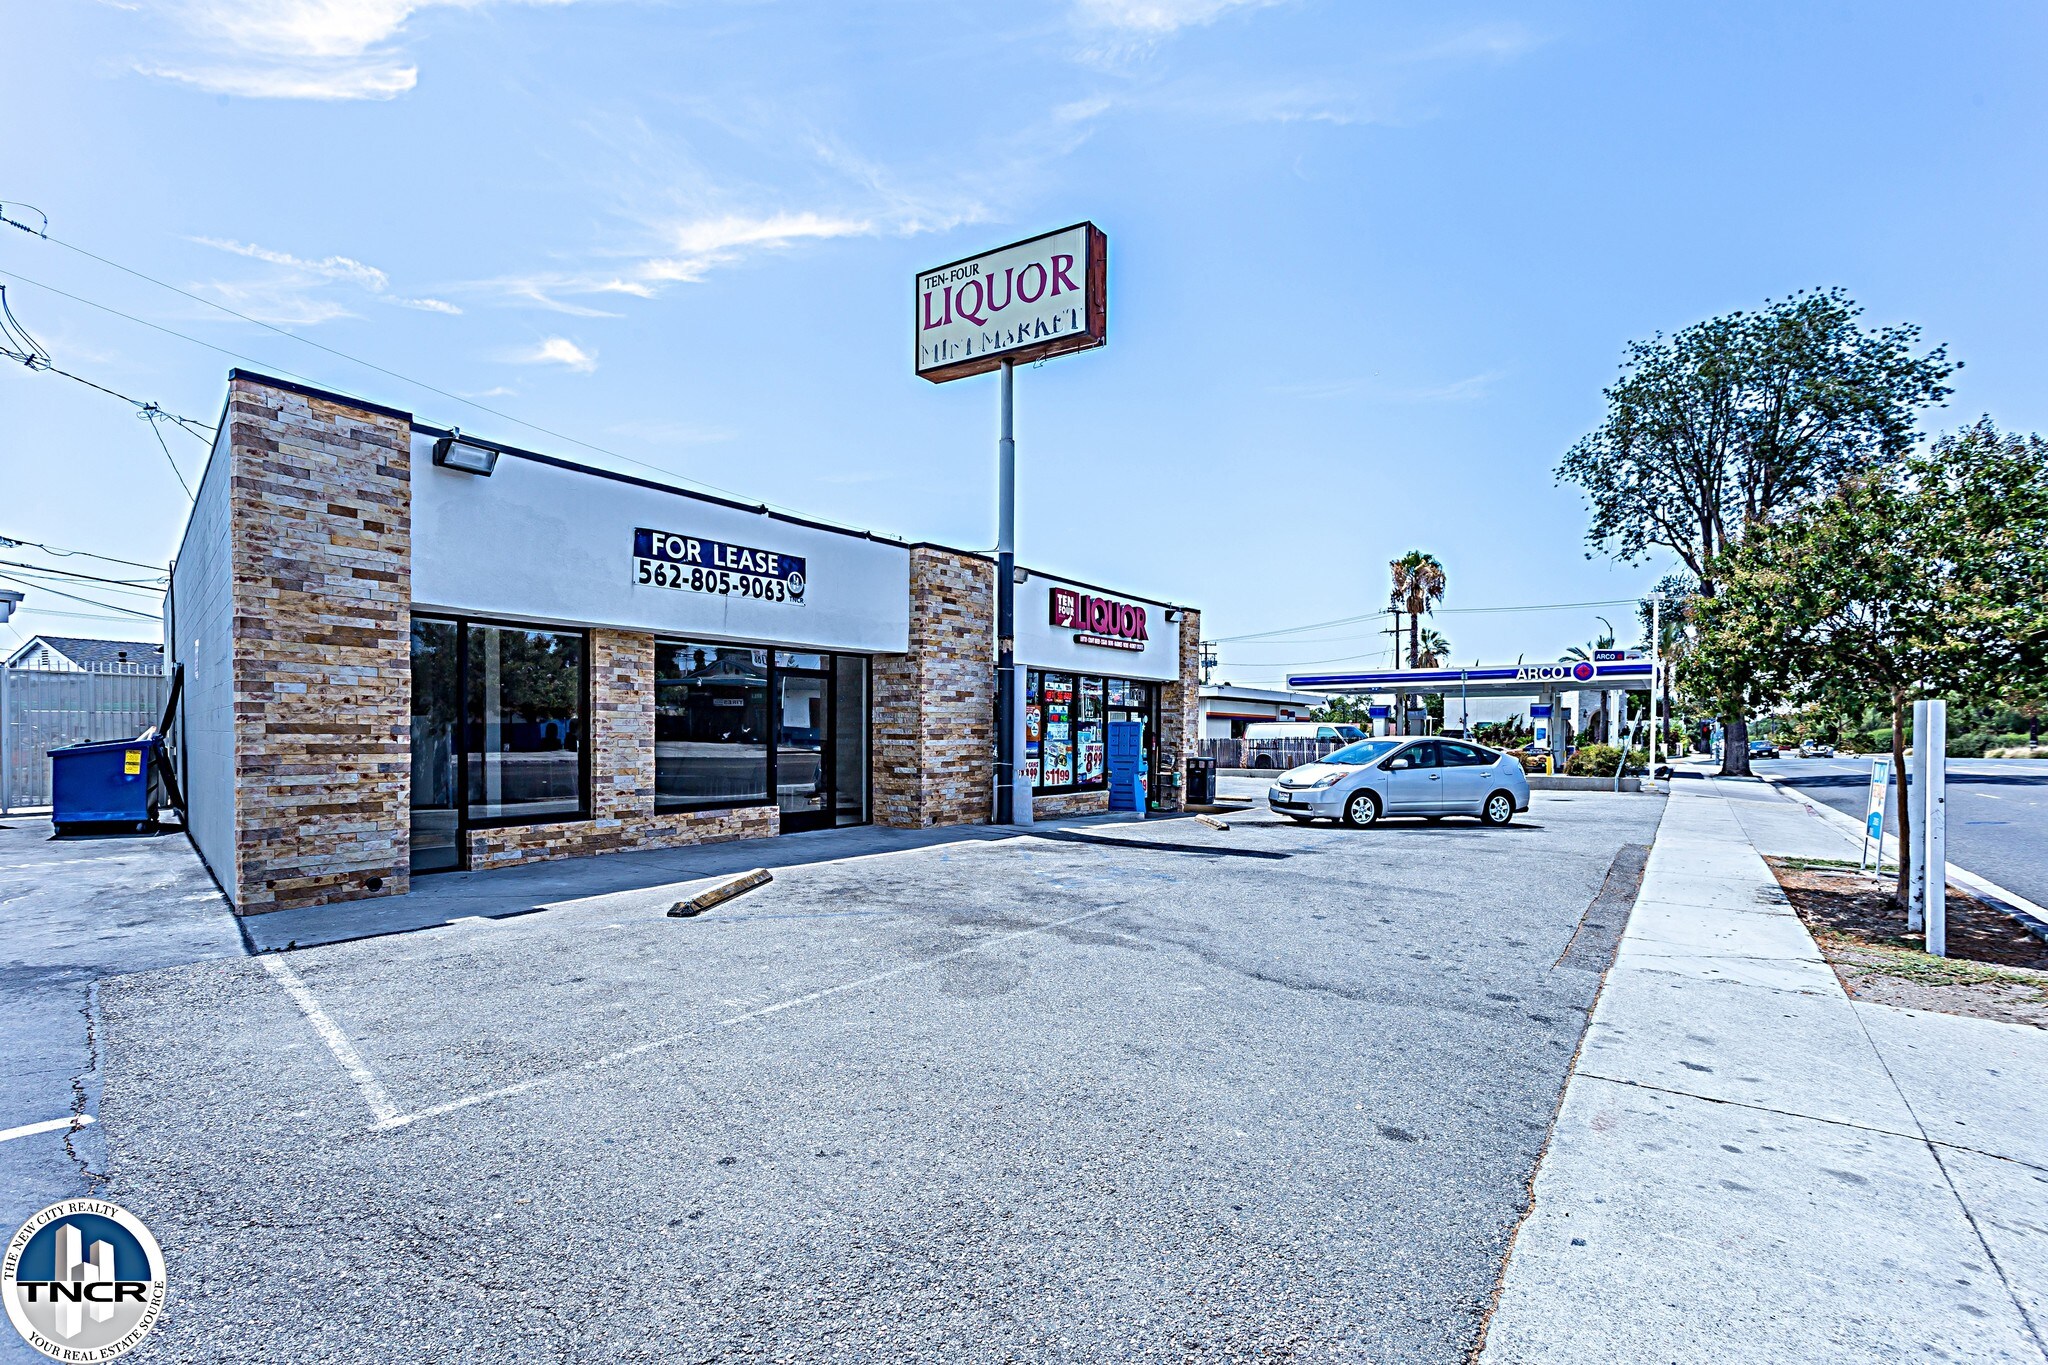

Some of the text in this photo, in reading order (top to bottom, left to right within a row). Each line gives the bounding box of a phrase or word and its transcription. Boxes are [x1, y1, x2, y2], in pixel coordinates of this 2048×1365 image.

[923, 254, 1080, 331] LIQUOR
[652, 532, 780, 575] FOR LEASE
[638, 560, 785, 602] 562-805-9063
[1057, 594, 1074, 608] TEN
[1058, 606, 1075, 617] FOUR
[1076, 595, 1149, 641] LIQUOR
[1516, 667, 1565, 681] ARCO
